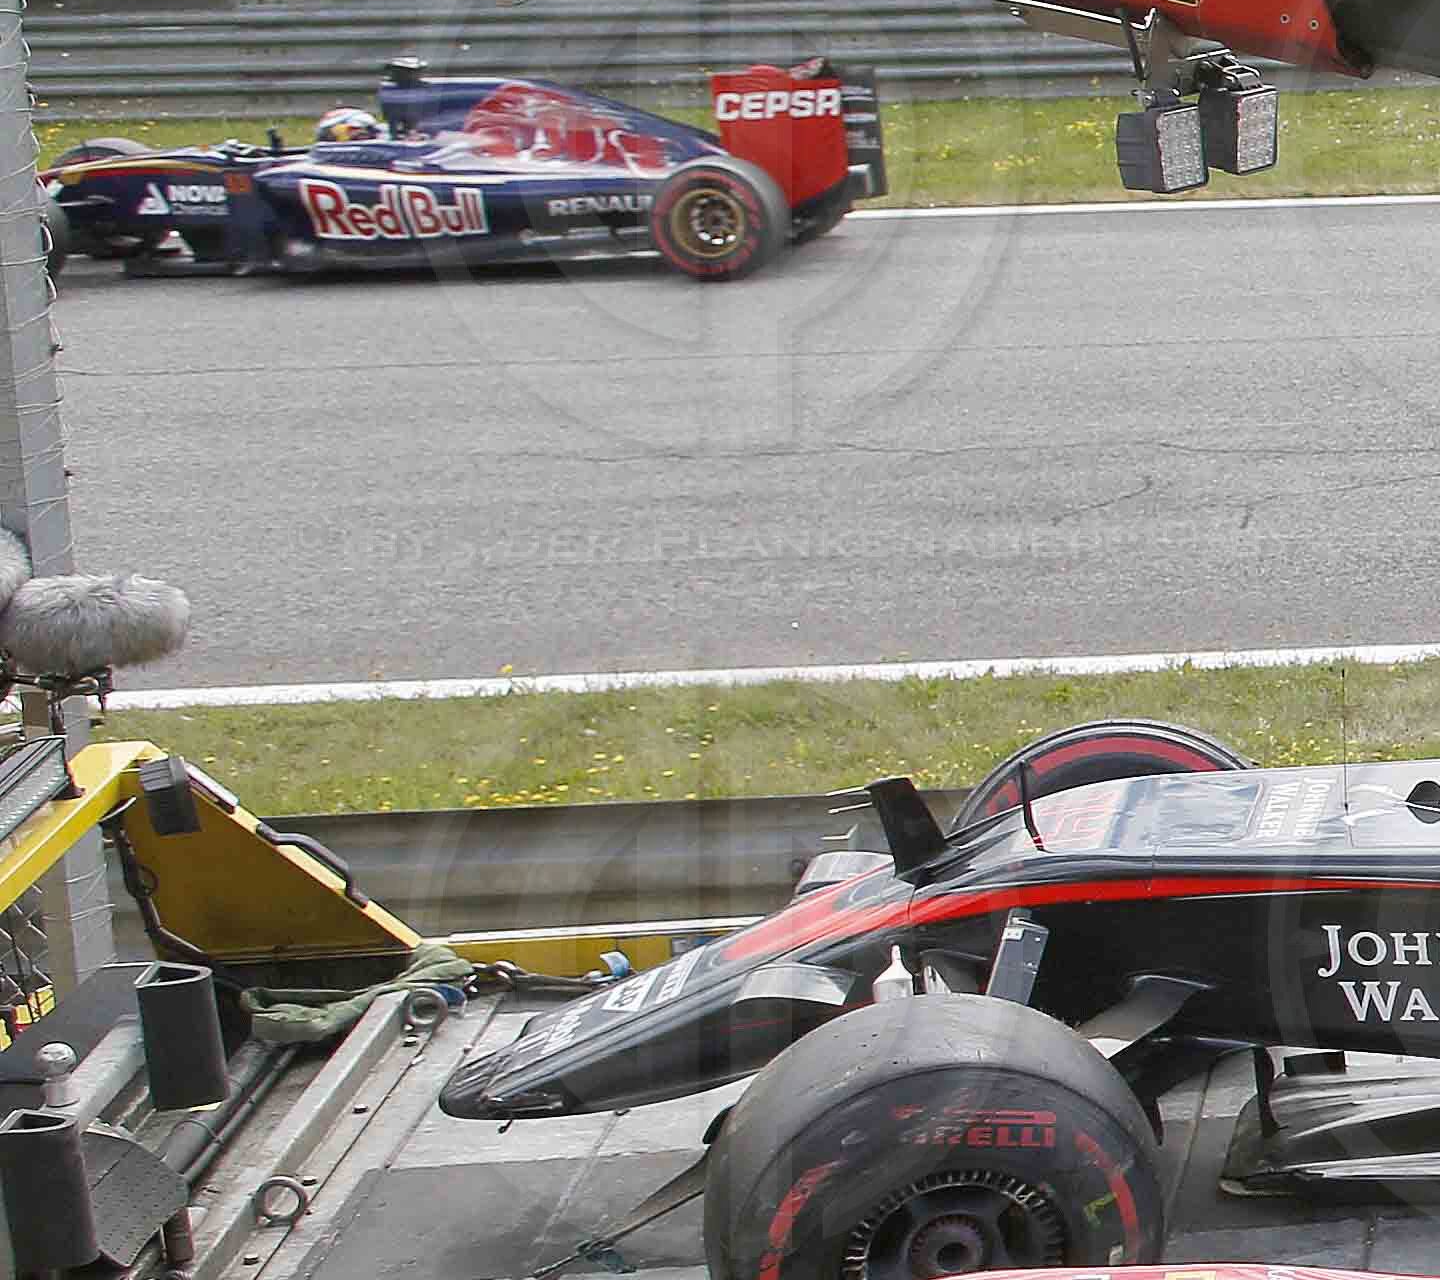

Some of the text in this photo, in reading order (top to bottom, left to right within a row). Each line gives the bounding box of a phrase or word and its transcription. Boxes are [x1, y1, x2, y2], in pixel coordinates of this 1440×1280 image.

[715, 89, 842, 120] CEPSA
[304, 179, 489, 239] Red Bull
